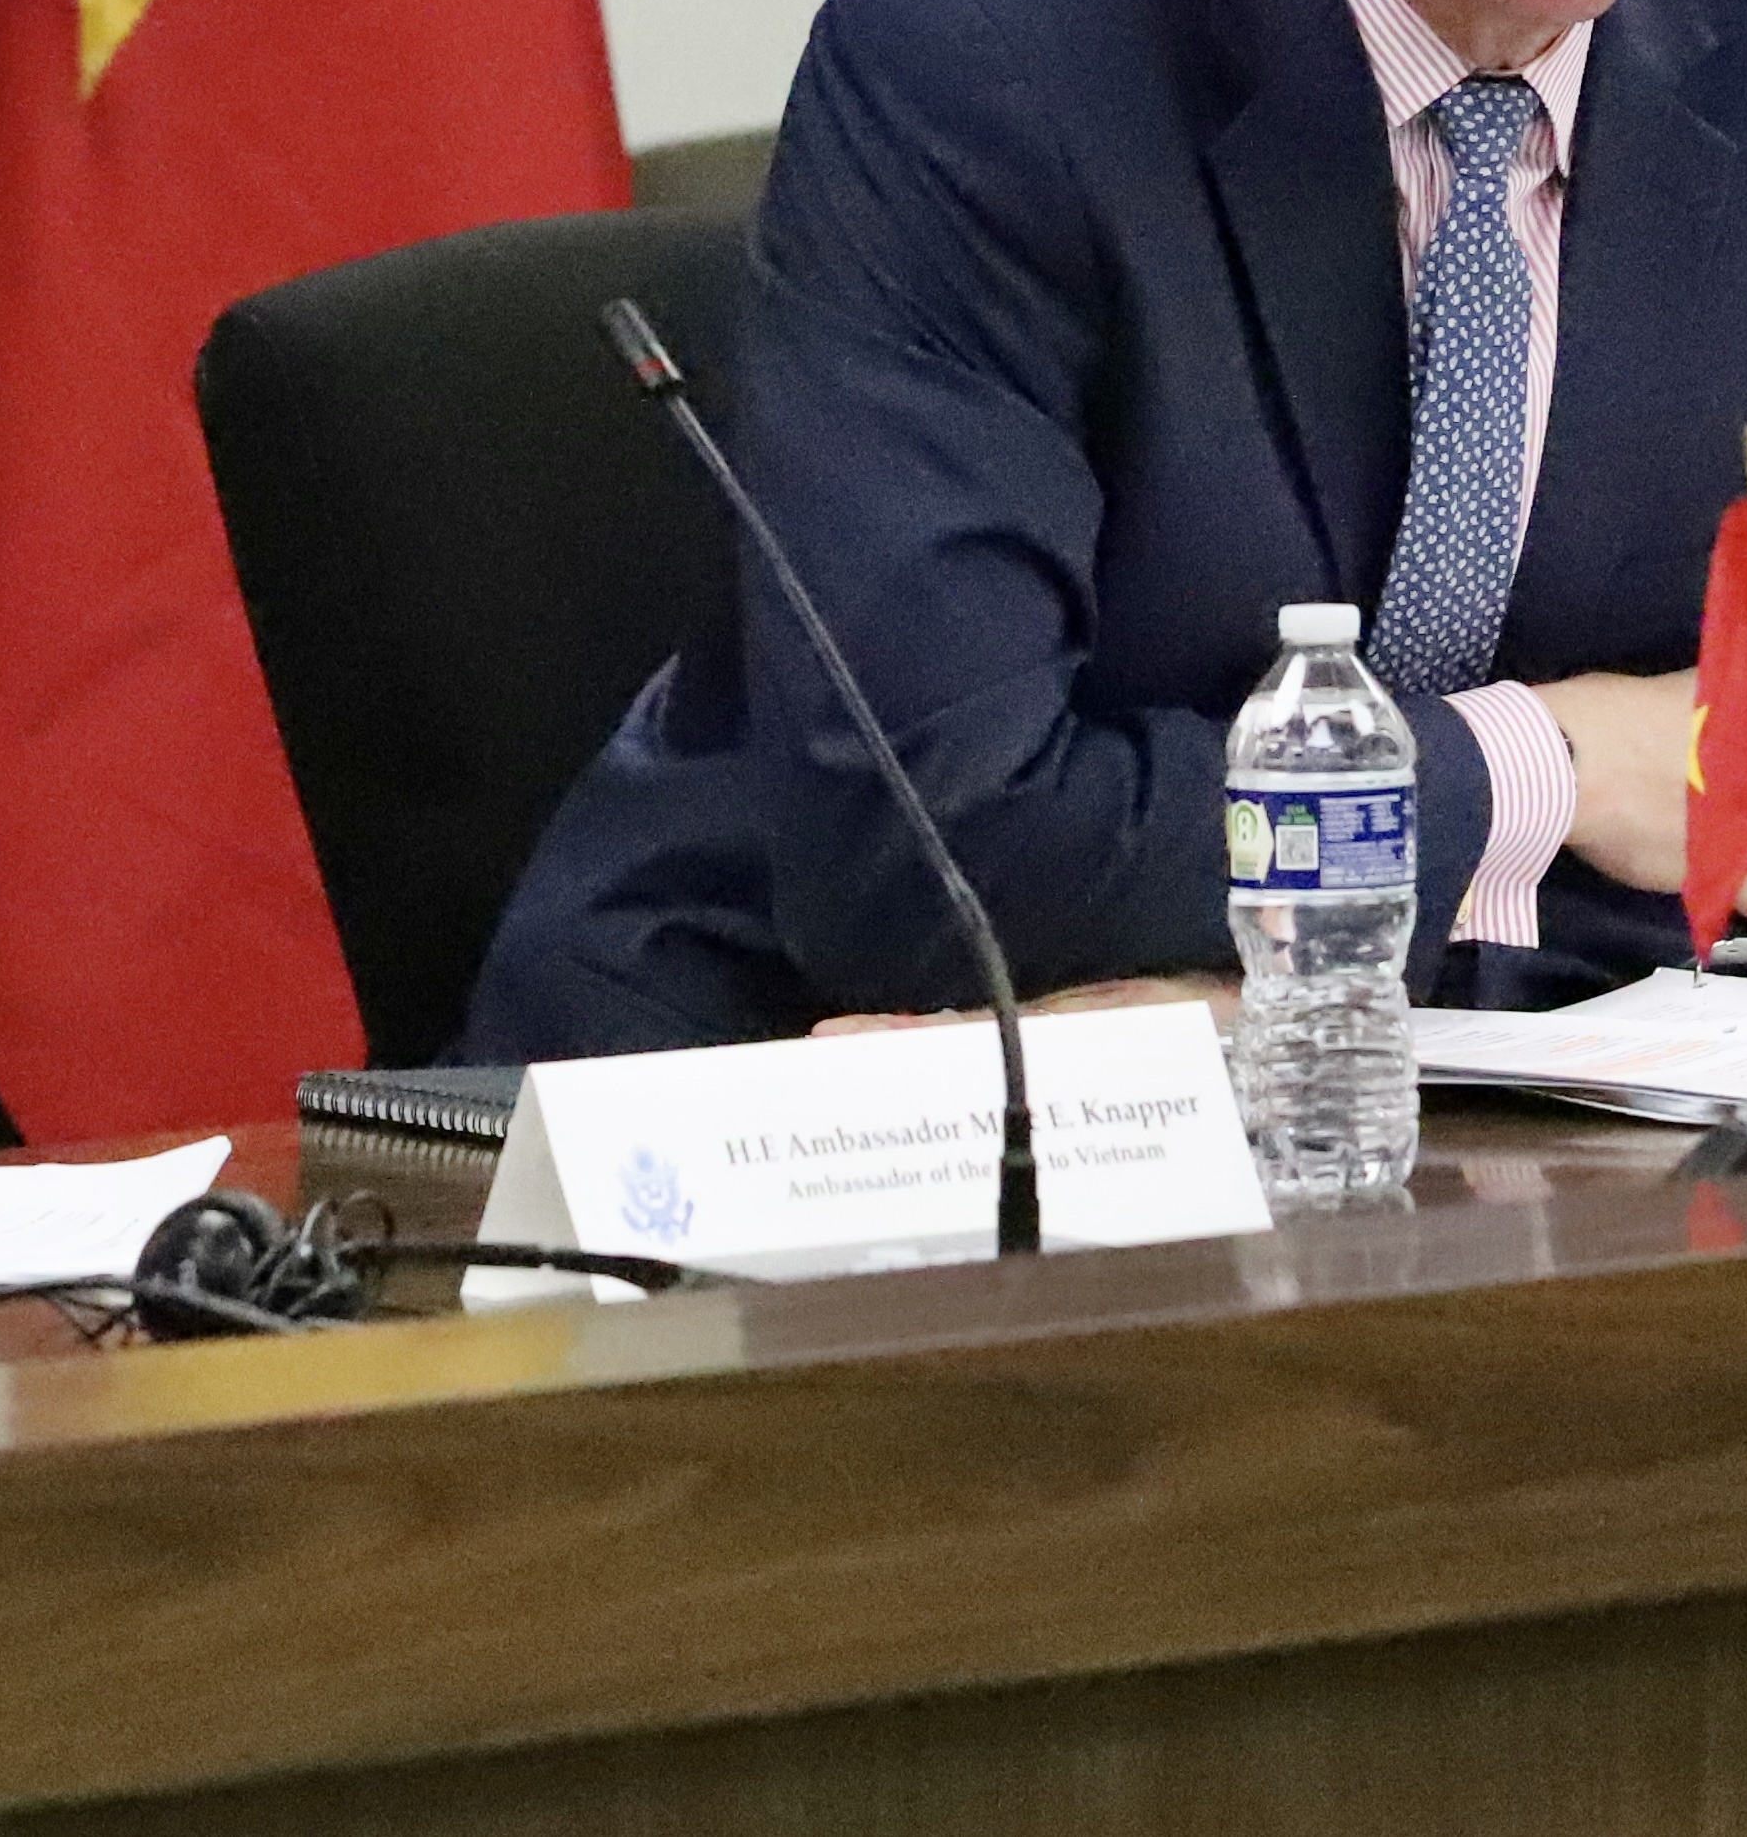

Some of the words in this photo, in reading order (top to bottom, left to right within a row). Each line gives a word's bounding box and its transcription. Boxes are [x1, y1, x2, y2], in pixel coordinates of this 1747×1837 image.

[789, 1116, 961, 1159] Ambassador
[1047, 1101, 1075, 1128] E.
[1080, 1095, 1199, 1130] Knapper
[787, 1166, 923, 1200] Ambassador
[930, 1160, 953, 1182] of
[958, 1158, 993, 1180] the
[1048, 1150, 1070, 1170] to
[1075, 1142, 1167, 1165] Vietnam
